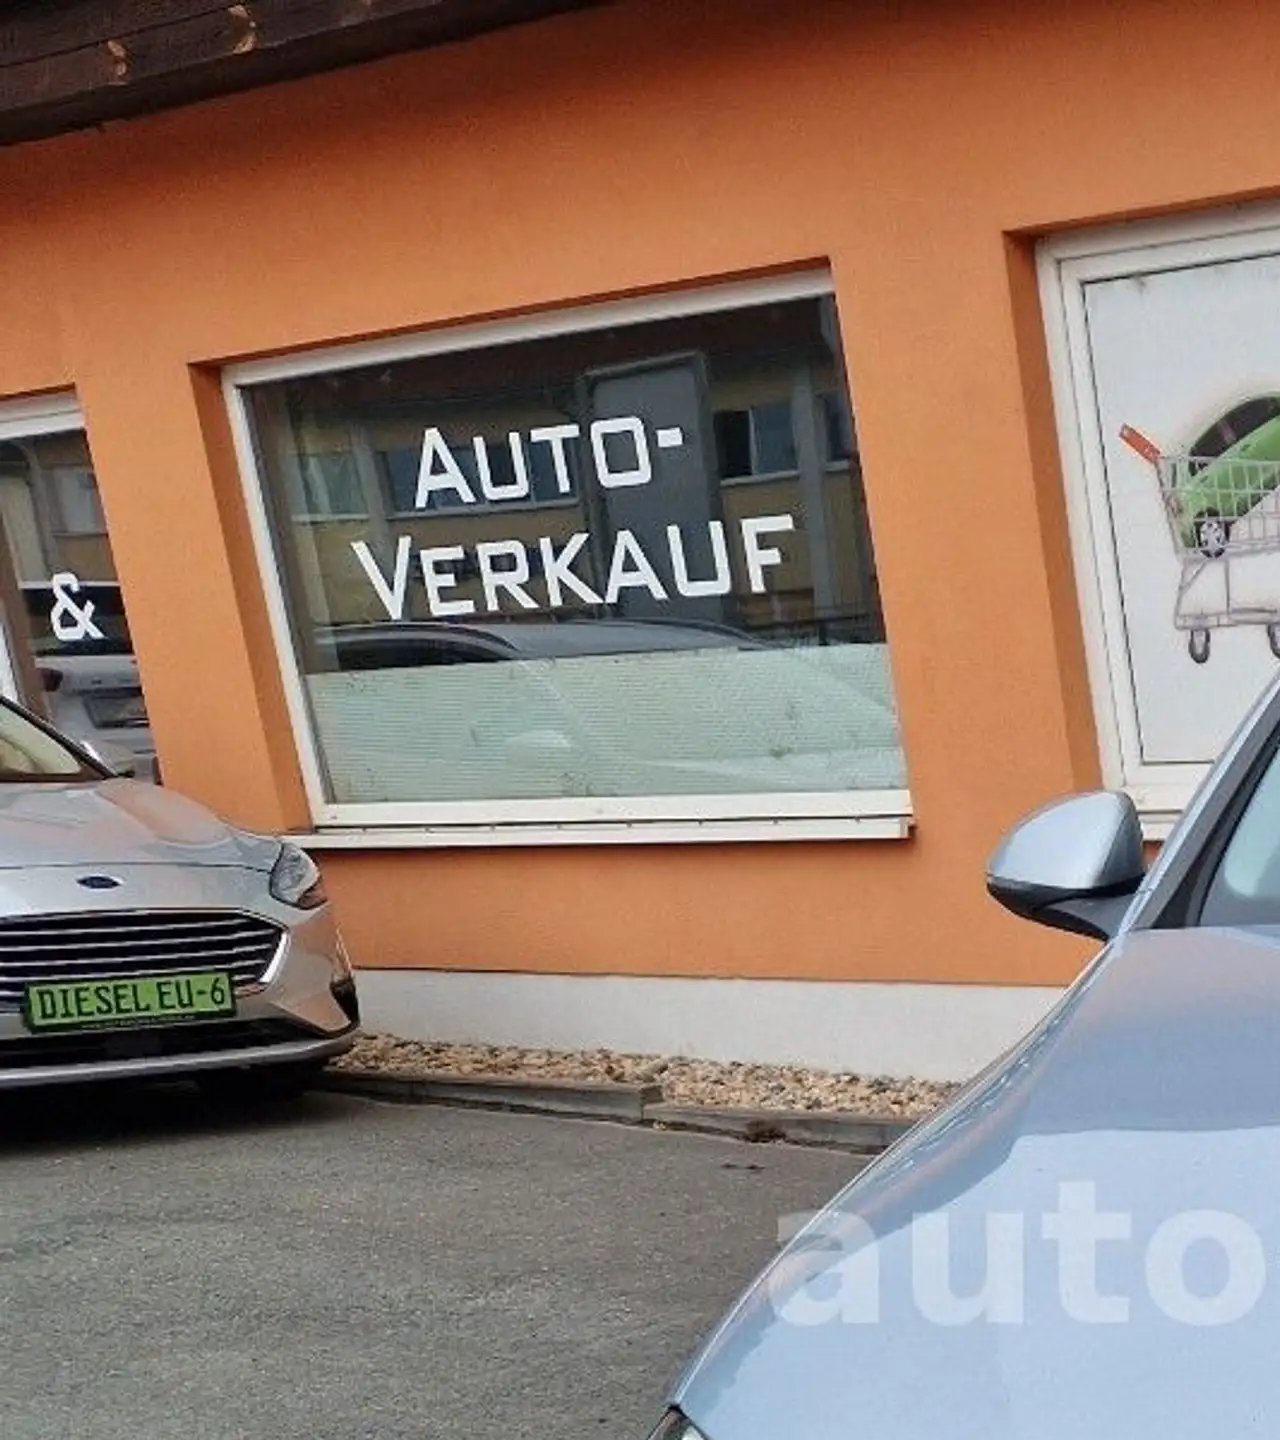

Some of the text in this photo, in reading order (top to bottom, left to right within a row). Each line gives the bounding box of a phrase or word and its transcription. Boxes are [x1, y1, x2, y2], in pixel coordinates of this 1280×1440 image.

[414, 416, 684, 509] AUTO-
[50, 571, 103, 641] &
[350, 514, 795, 622] VERKAUF
[38, 975, 226, 1018] DIESEL EU-6
